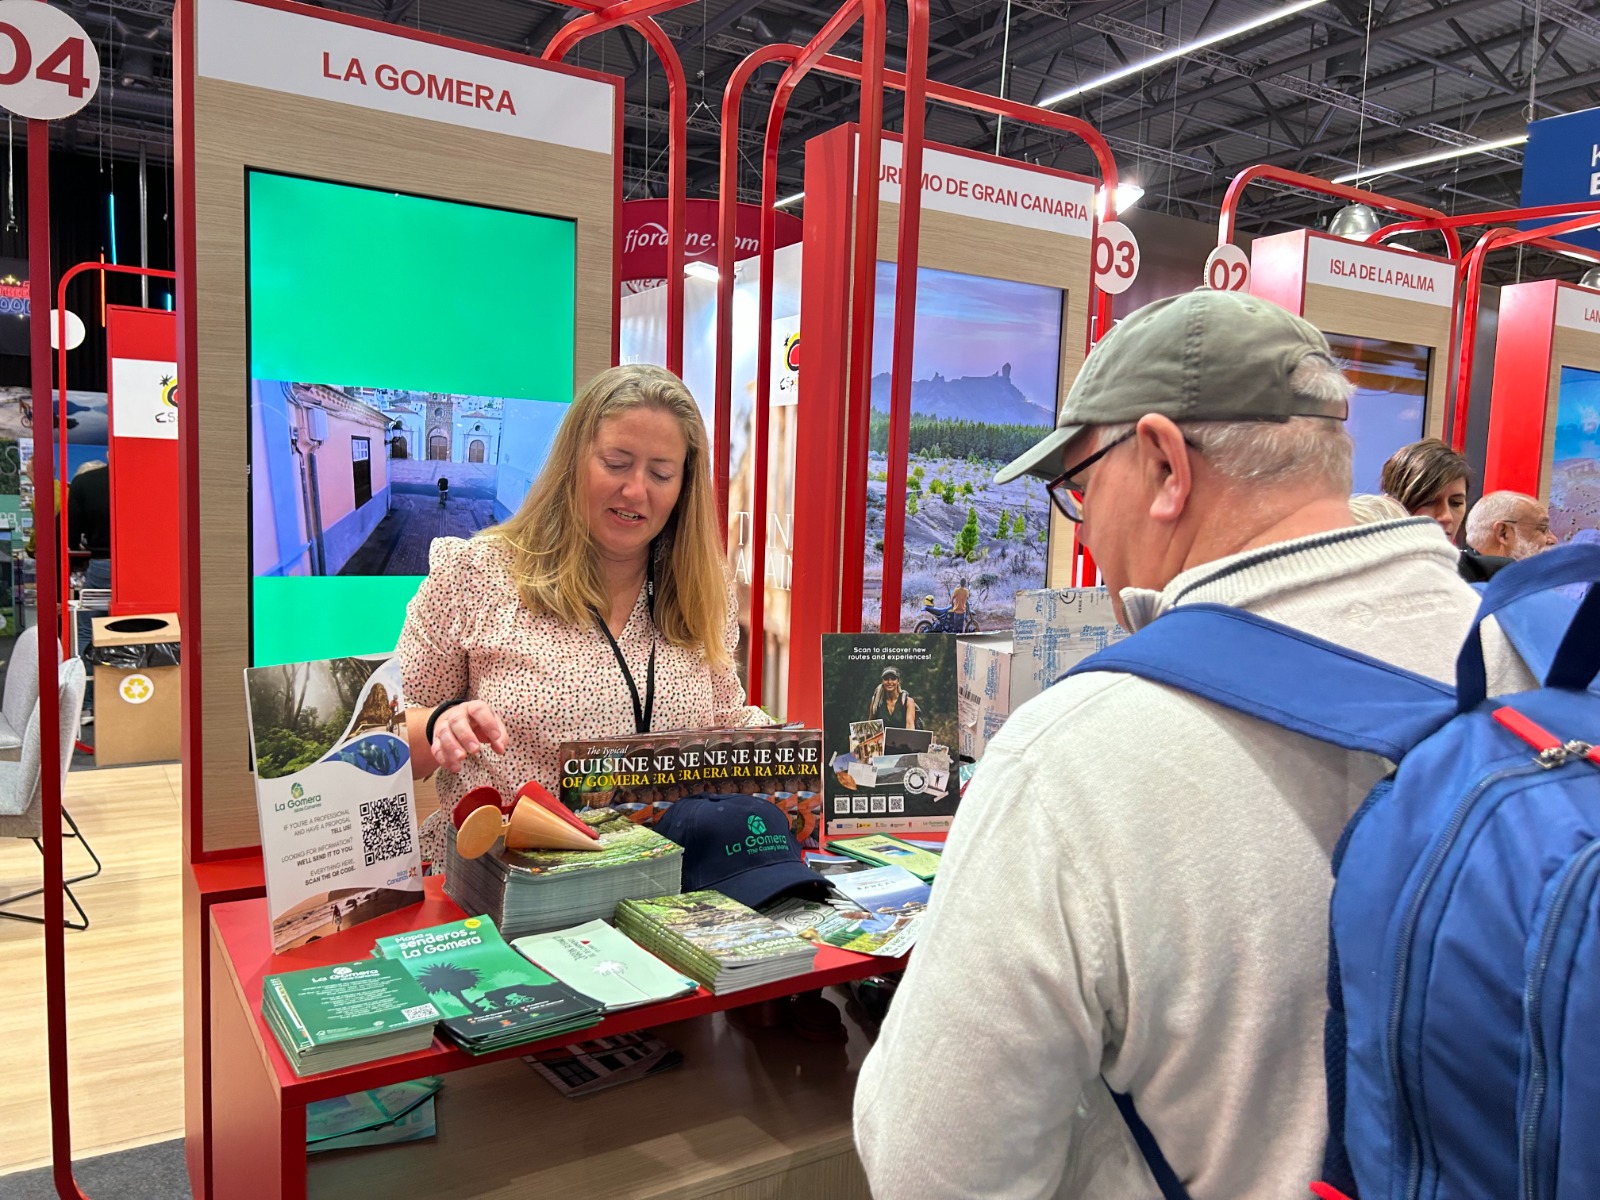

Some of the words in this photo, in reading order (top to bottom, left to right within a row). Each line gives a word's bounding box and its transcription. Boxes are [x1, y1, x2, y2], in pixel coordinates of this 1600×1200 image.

[323, 52, 367, 86] LA
[374, 64, 517, 116] GOMERA
[946, 178, 968, 198] DE
[972, 183, 1018, 208] GRAN
[1020, 193, 1088, 222] CANARIA
[1094, 236, 1135, 278] 03
[1210, 258, 1248, 291] 02
[1330, 258, 1358, 278] ISLA
[1359, 264, 1376, 281] DE
[1378, 268, 1394, 284] LA
[1395, 270, 1435, 292] PALMA
[586, 745, 600, 755] The
[602, 744, 630, 758] Typical
[564, 756, 650, 774] CUISINE
[704, 767, 728, 778] ERA
[562, 776, 583, 788] OF
[586, 774, 650, 788] GOMERA
[275, 803, 286, 812] La
[288, 794, 322, 808] Gomera
[314, 809, 350, 822] PROFESSIONAL
[306, 824, 320, 833] HAVE
[325, 816, 351, 828] PROPOSAL
[726, 842, 742, 856] La
[745, 834, 786, 847] Gomera
[282, 850, 305, 863] LOOKING
[306, 848, 316, 856] FOR
[312, 854, 326, 862] SEND
[310, 862, 340, 876] EVERYTHING
[305, 876, 320, 886] SCAN
[322, 872, 331, 880] THE
[395, 934, 424, 944] Mapa
[400, 929, 468, 950] senderos
[402, 948, 422, 960] La
[424, 936, 482, 954] Gomera
[330, 970, 378, 980] Gomera
